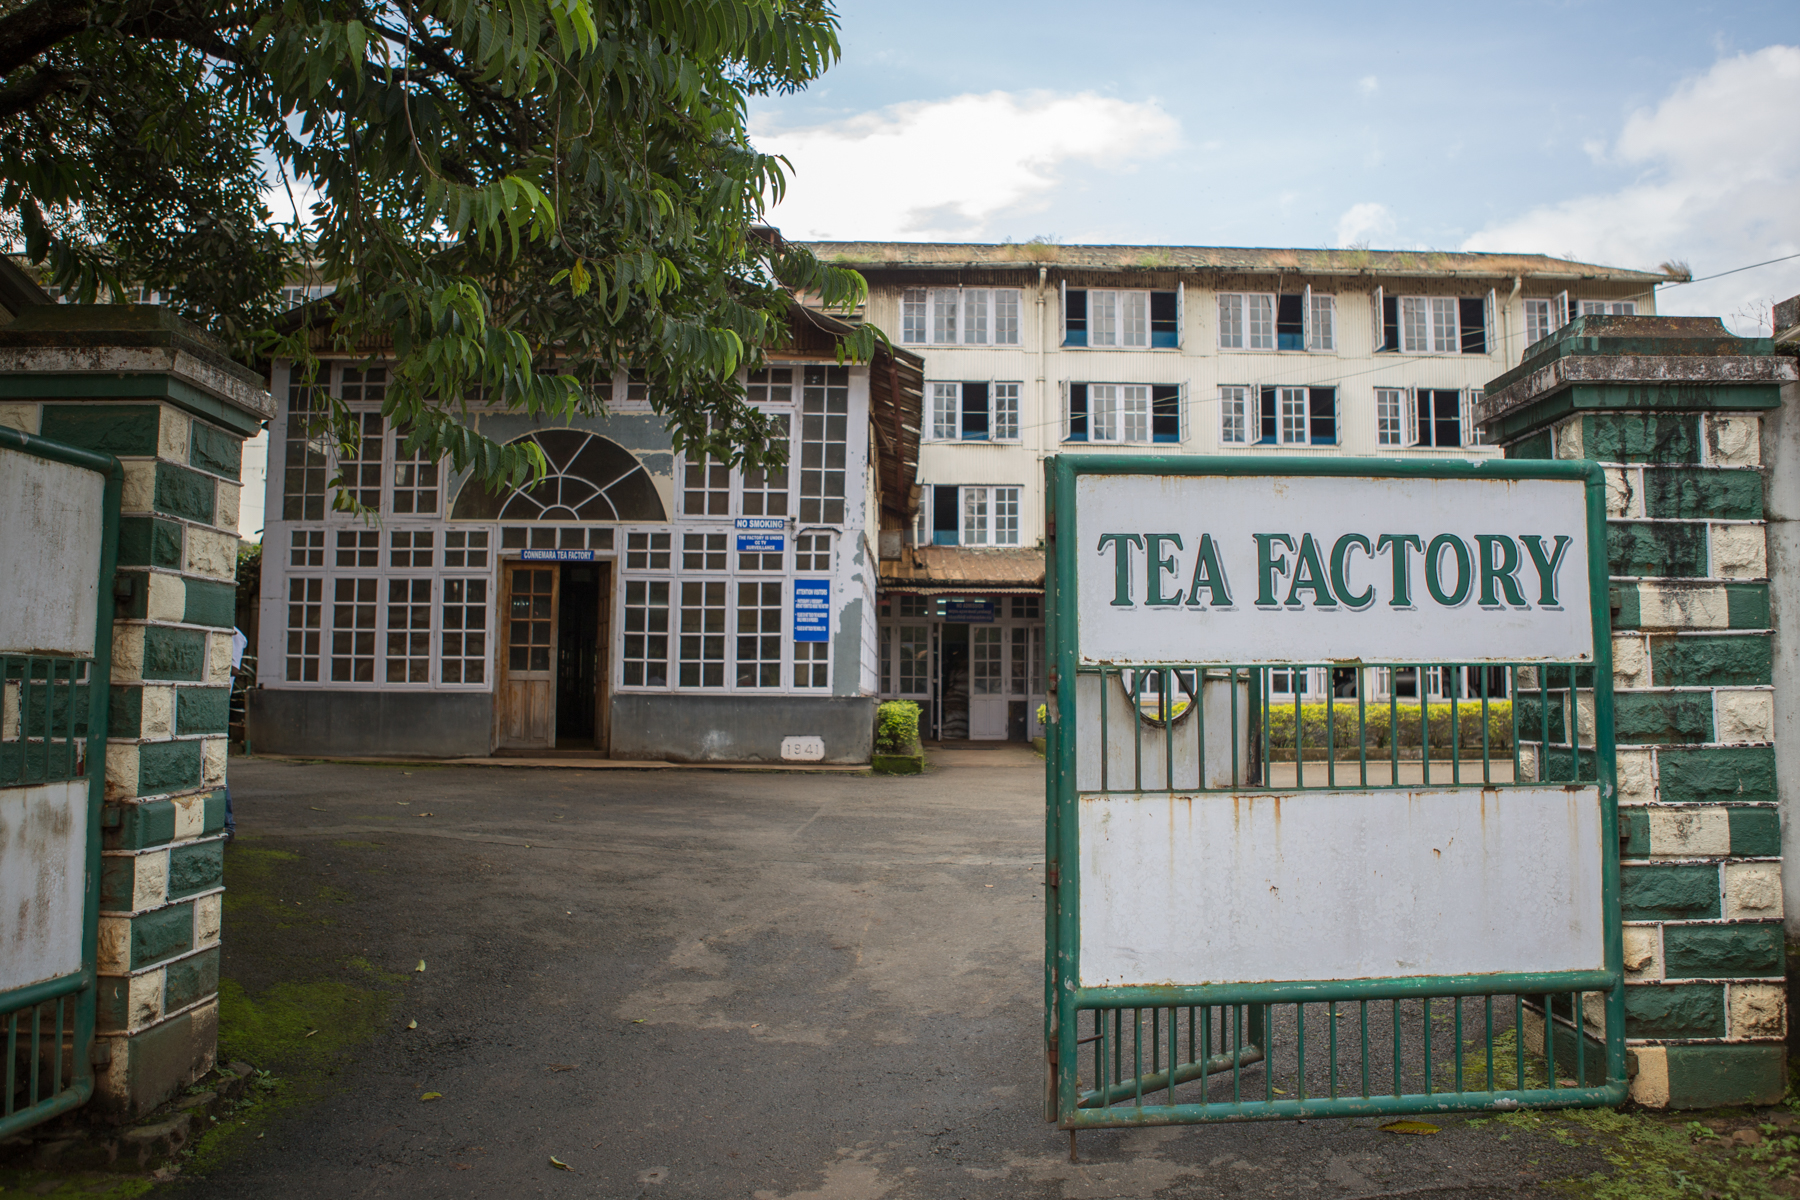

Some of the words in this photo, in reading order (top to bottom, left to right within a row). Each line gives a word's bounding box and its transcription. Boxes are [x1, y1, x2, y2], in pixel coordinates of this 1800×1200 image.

[737, 520, 748, 528] NO
[749, 520, 783, 528] SMOKING
[523, 550, 556, 559] CONNEMARA
[557, 551, 568, 559] TEA
[568, 551, 592, 560] FACTORY
[1097, 532, 1238, 611] TEA
[1252, 532, 1573, 611] FACTORY
[786, 743, 819, 756] 1941
